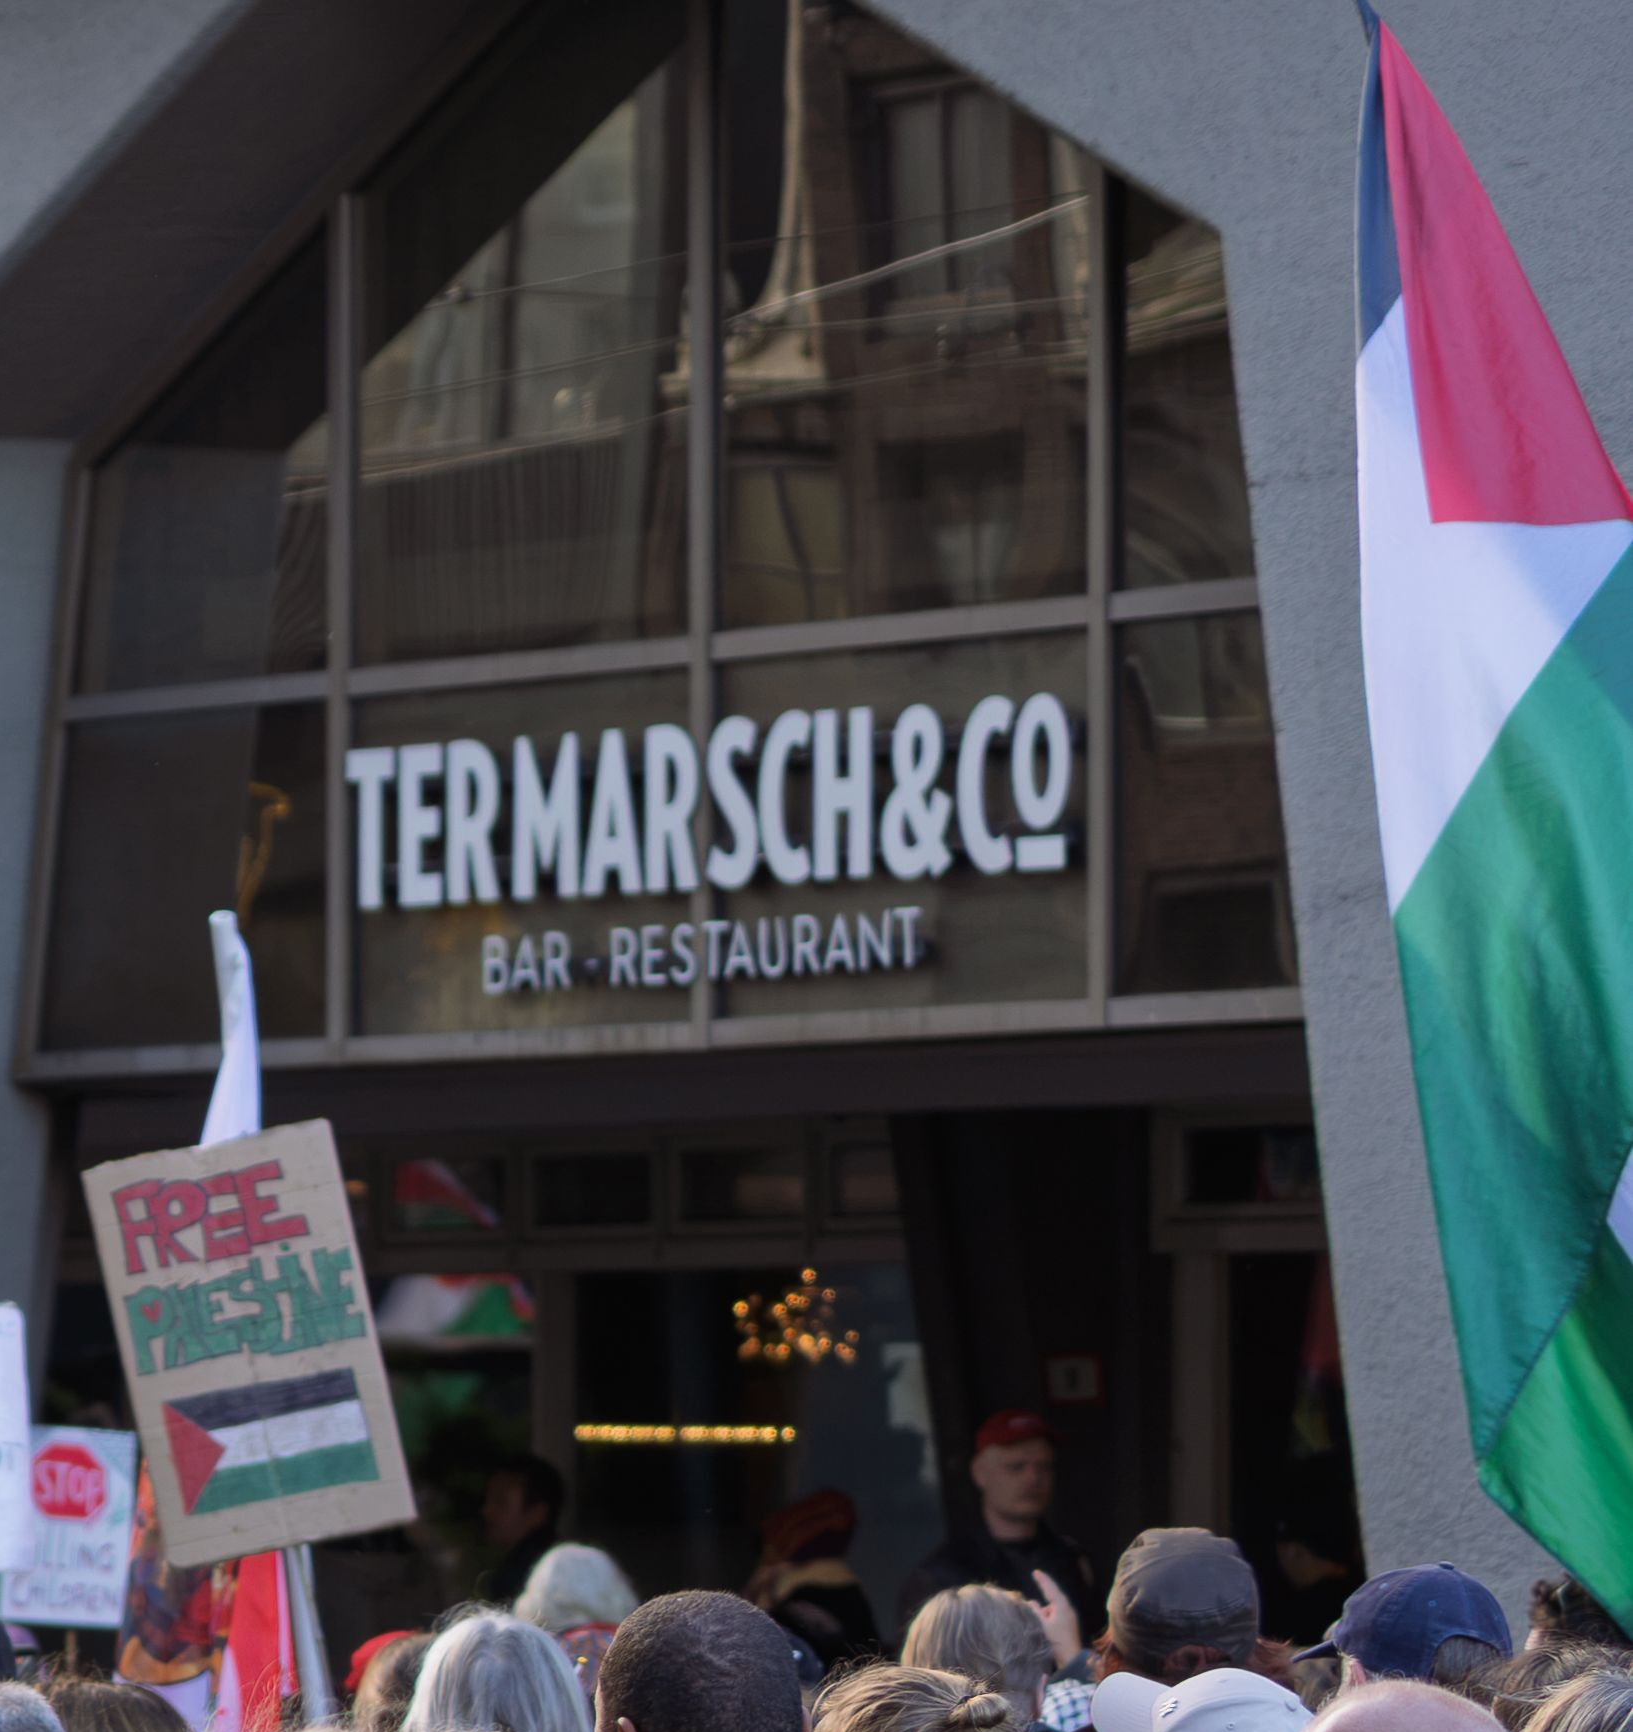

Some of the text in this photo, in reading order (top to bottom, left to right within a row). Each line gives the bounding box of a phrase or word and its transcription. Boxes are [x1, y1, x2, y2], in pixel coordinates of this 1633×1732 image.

[482, 905, 924, 996] BAR RESTAURANT
[111, 1158, 310, 1276] FREE
[34, 1459, 105, 1514] STOP
